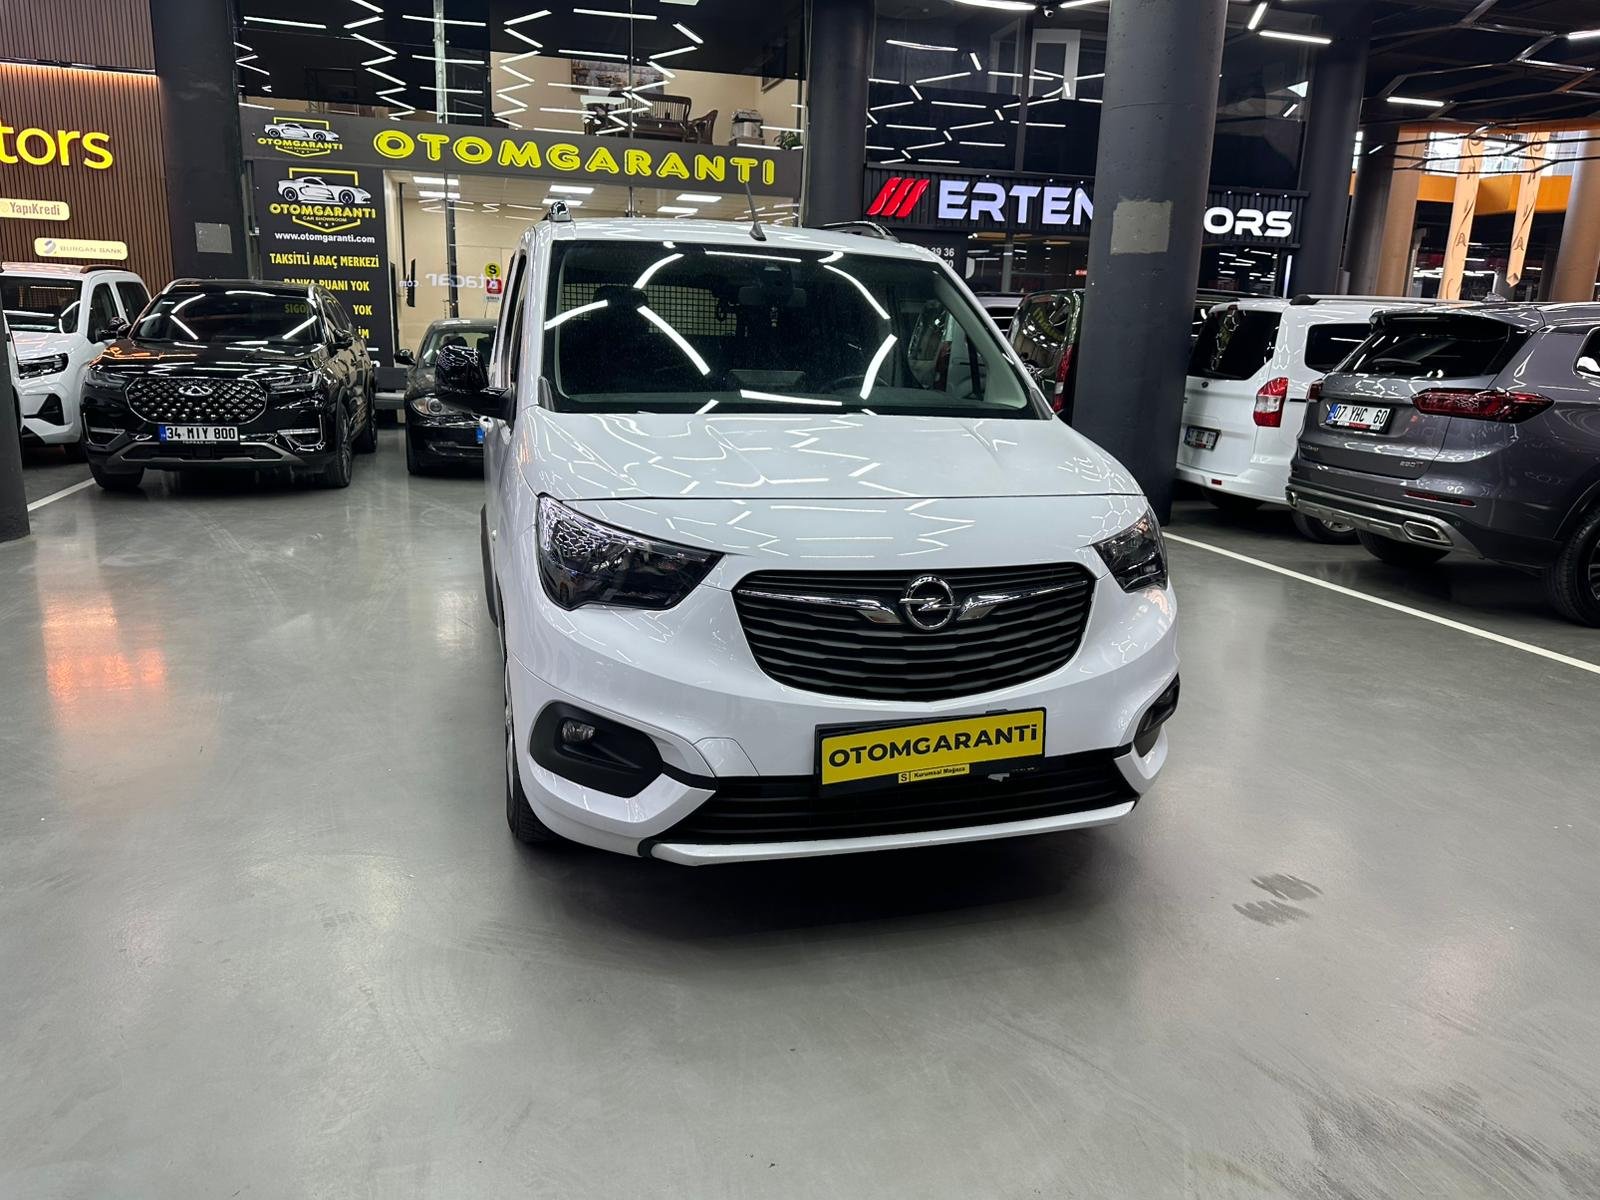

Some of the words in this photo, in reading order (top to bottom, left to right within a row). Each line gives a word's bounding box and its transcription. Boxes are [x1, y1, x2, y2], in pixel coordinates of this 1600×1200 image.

[0, 119, 113, 169] tors
[257, 137, 343, 150] OTOMGARANTI
[372, 129, 775, 186] OTOMGARANTI
[9, 201, 61, 216] YapıKredi
[937, 179, 1095, 226] ERTEN
[269, 203, 376, 219] OTOMGARANTI
[275, 232, 375, 244] www.otomgaranti.com
[60, 245, 97, 253] BURGAN
[99, 247, 122, 255] BANK
[943, 247, 955, 257] 36
[269, 251, 311, 265] TAKSİTLİ
[313, 255, 338, 269] ARAÇ
[340, 255, 380, 267] MERKEZİ
[350, 280, 370, 292] YOK
[352, 304, 373, 315] YOK
[1333, 406, 1347, 420] 07
[1349, 407, 1368, 422] YHC
[1373, 410, 1388, 425] 60
[166, 427, 181, 439] 34
[187, 428, 208, 439] MIY
[213, 428, 236, 439] 800
[829, 724, 1038, 768] OTOMGARANTi
[914, 769, 942, 779] Kurumsal
